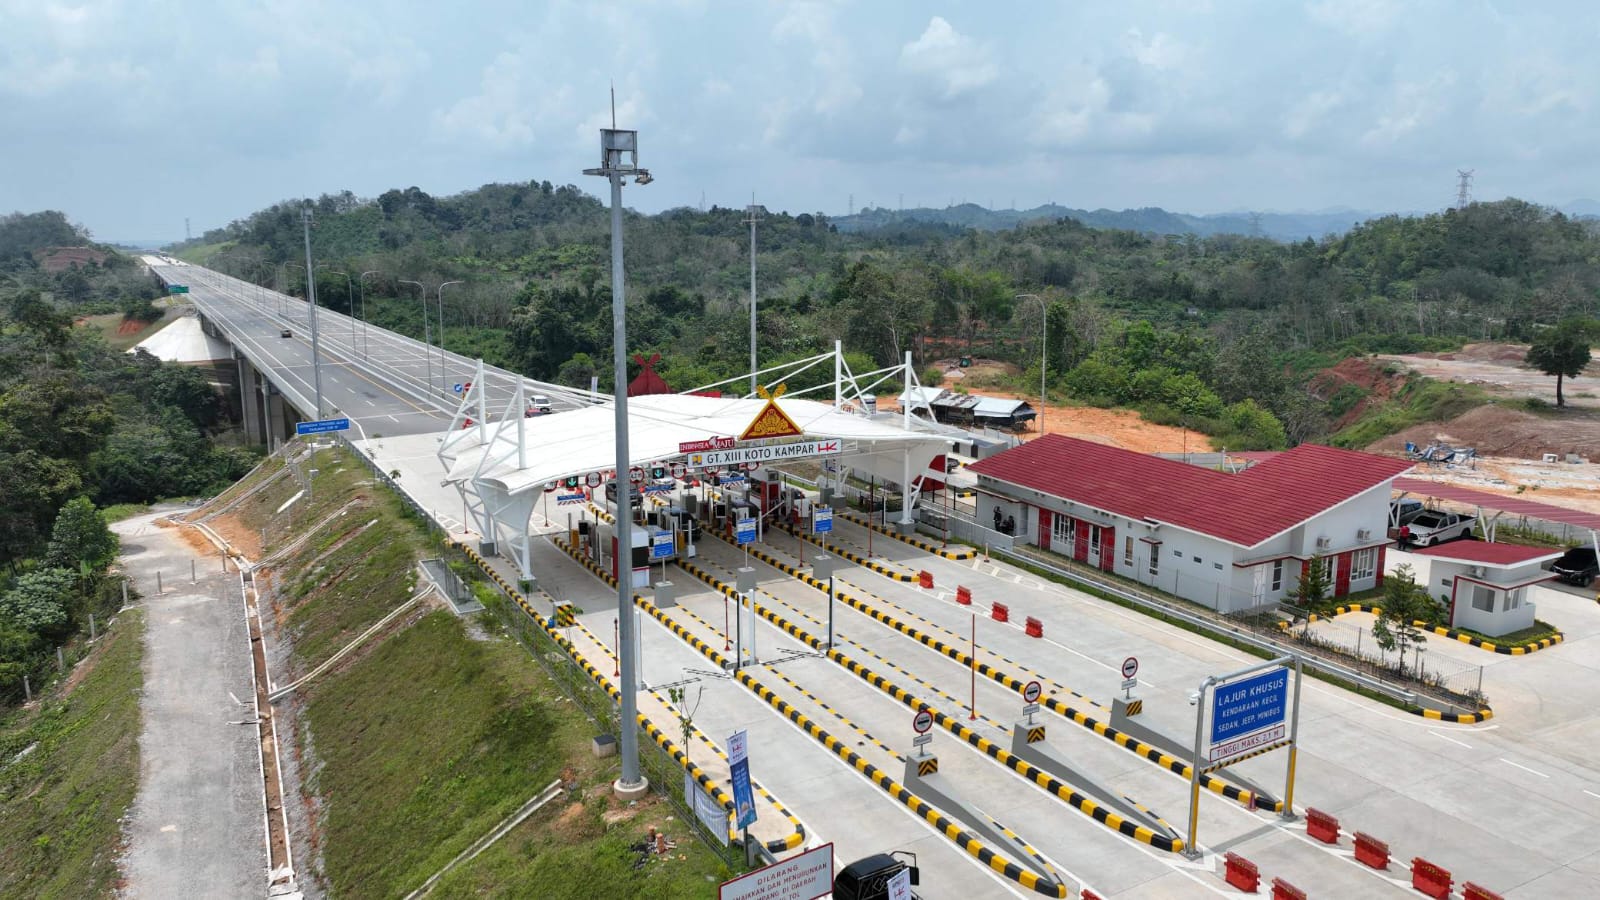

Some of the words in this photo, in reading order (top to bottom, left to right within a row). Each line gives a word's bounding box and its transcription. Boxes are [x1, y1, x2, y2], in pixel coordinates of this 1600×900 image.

[707, 453, 722, 464] GT.
[724, 451, 741, 462] XIII
[744, 448, 771, 460] KOTO
[775, 444, 814, 457] KAMPAR
[818, 442, 837, 452] HK
[713, 439, 734, 449] MAJU
[1218, 689, 1247, 706] LAJUR
[1250, 678, 1284, 696] KHUSUS
[1222, 700, 1259, 718] KENDARAAN
[1261, 694, 1278, 705] KECIL
[1257, 706, 1281, 720] MINIBUS
[1217, 744, 1240, 757] TINGGI
[757, 864, 799, 886] DILARANG
[791, 876, 816, 890] DAERAH
[733, 887, 765, 900] NAIKKAN
[767, 881, 781, 890] DAN
